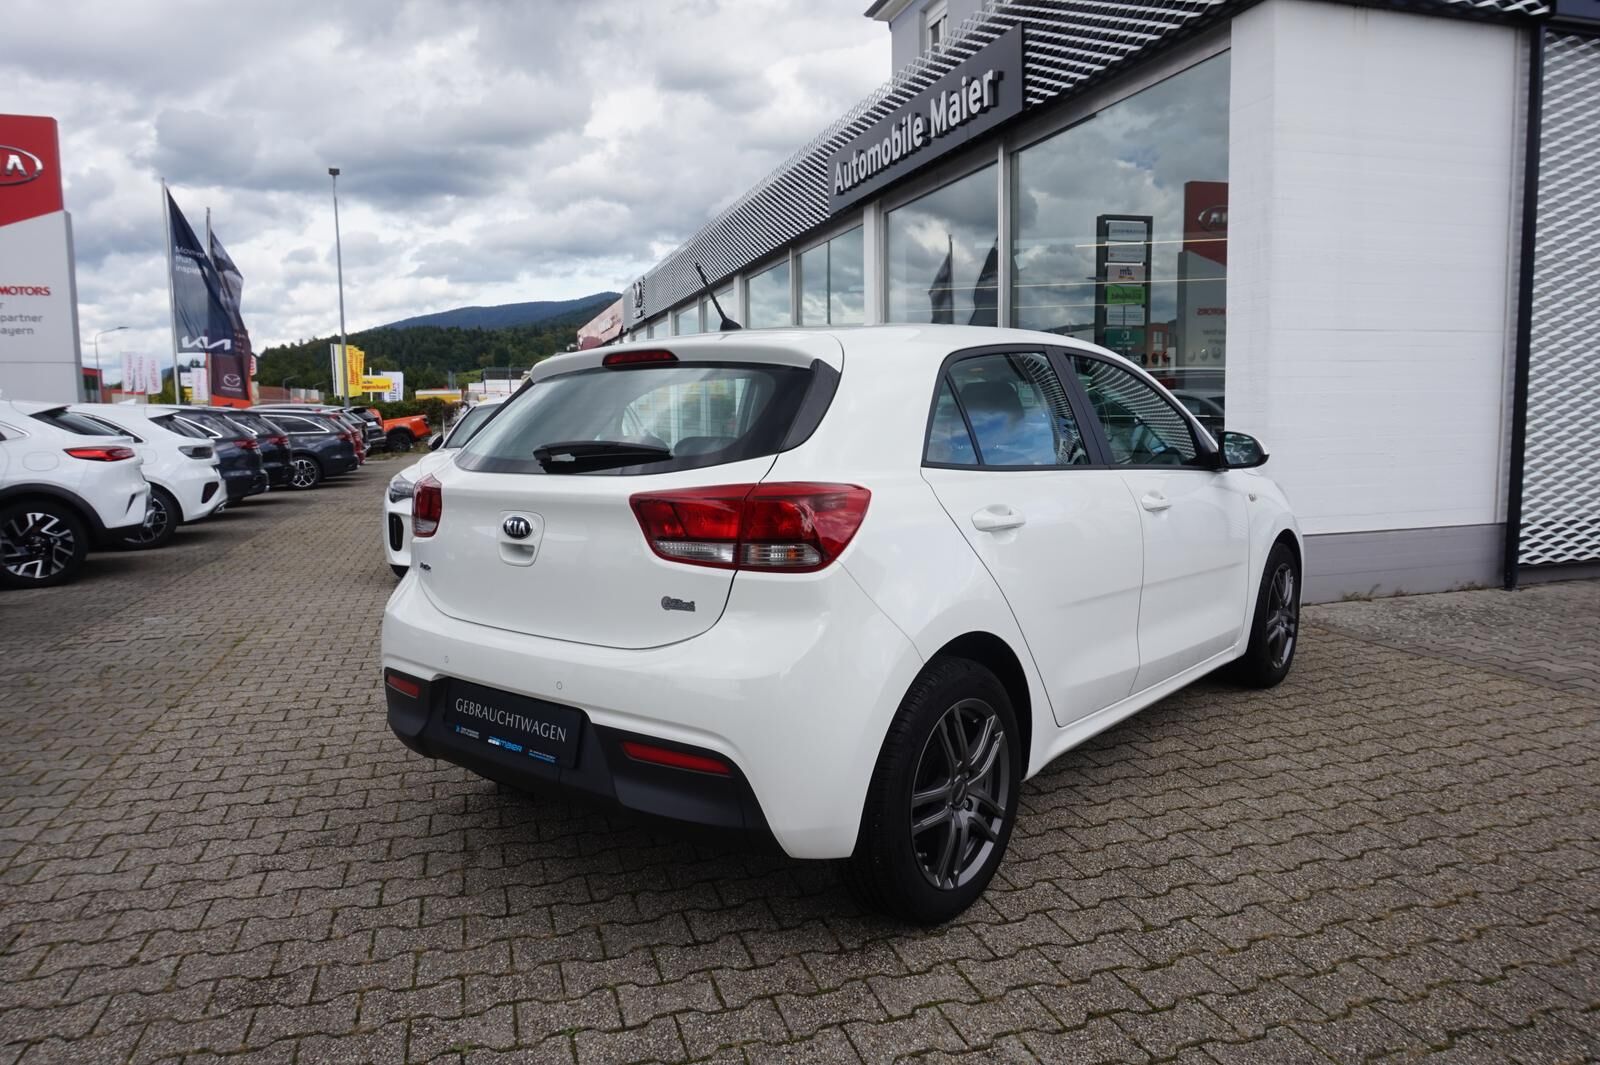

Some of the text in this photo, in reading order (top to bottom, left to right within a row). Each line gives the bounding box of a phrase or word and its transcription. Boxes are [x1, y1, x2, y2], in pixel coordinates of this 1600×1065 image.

[834, 69, 996, 195] Automobile Maier
[506, 520, 527, 535] KIA
[455, 698, 567, 742] GEBRAUCHTWAGEN
